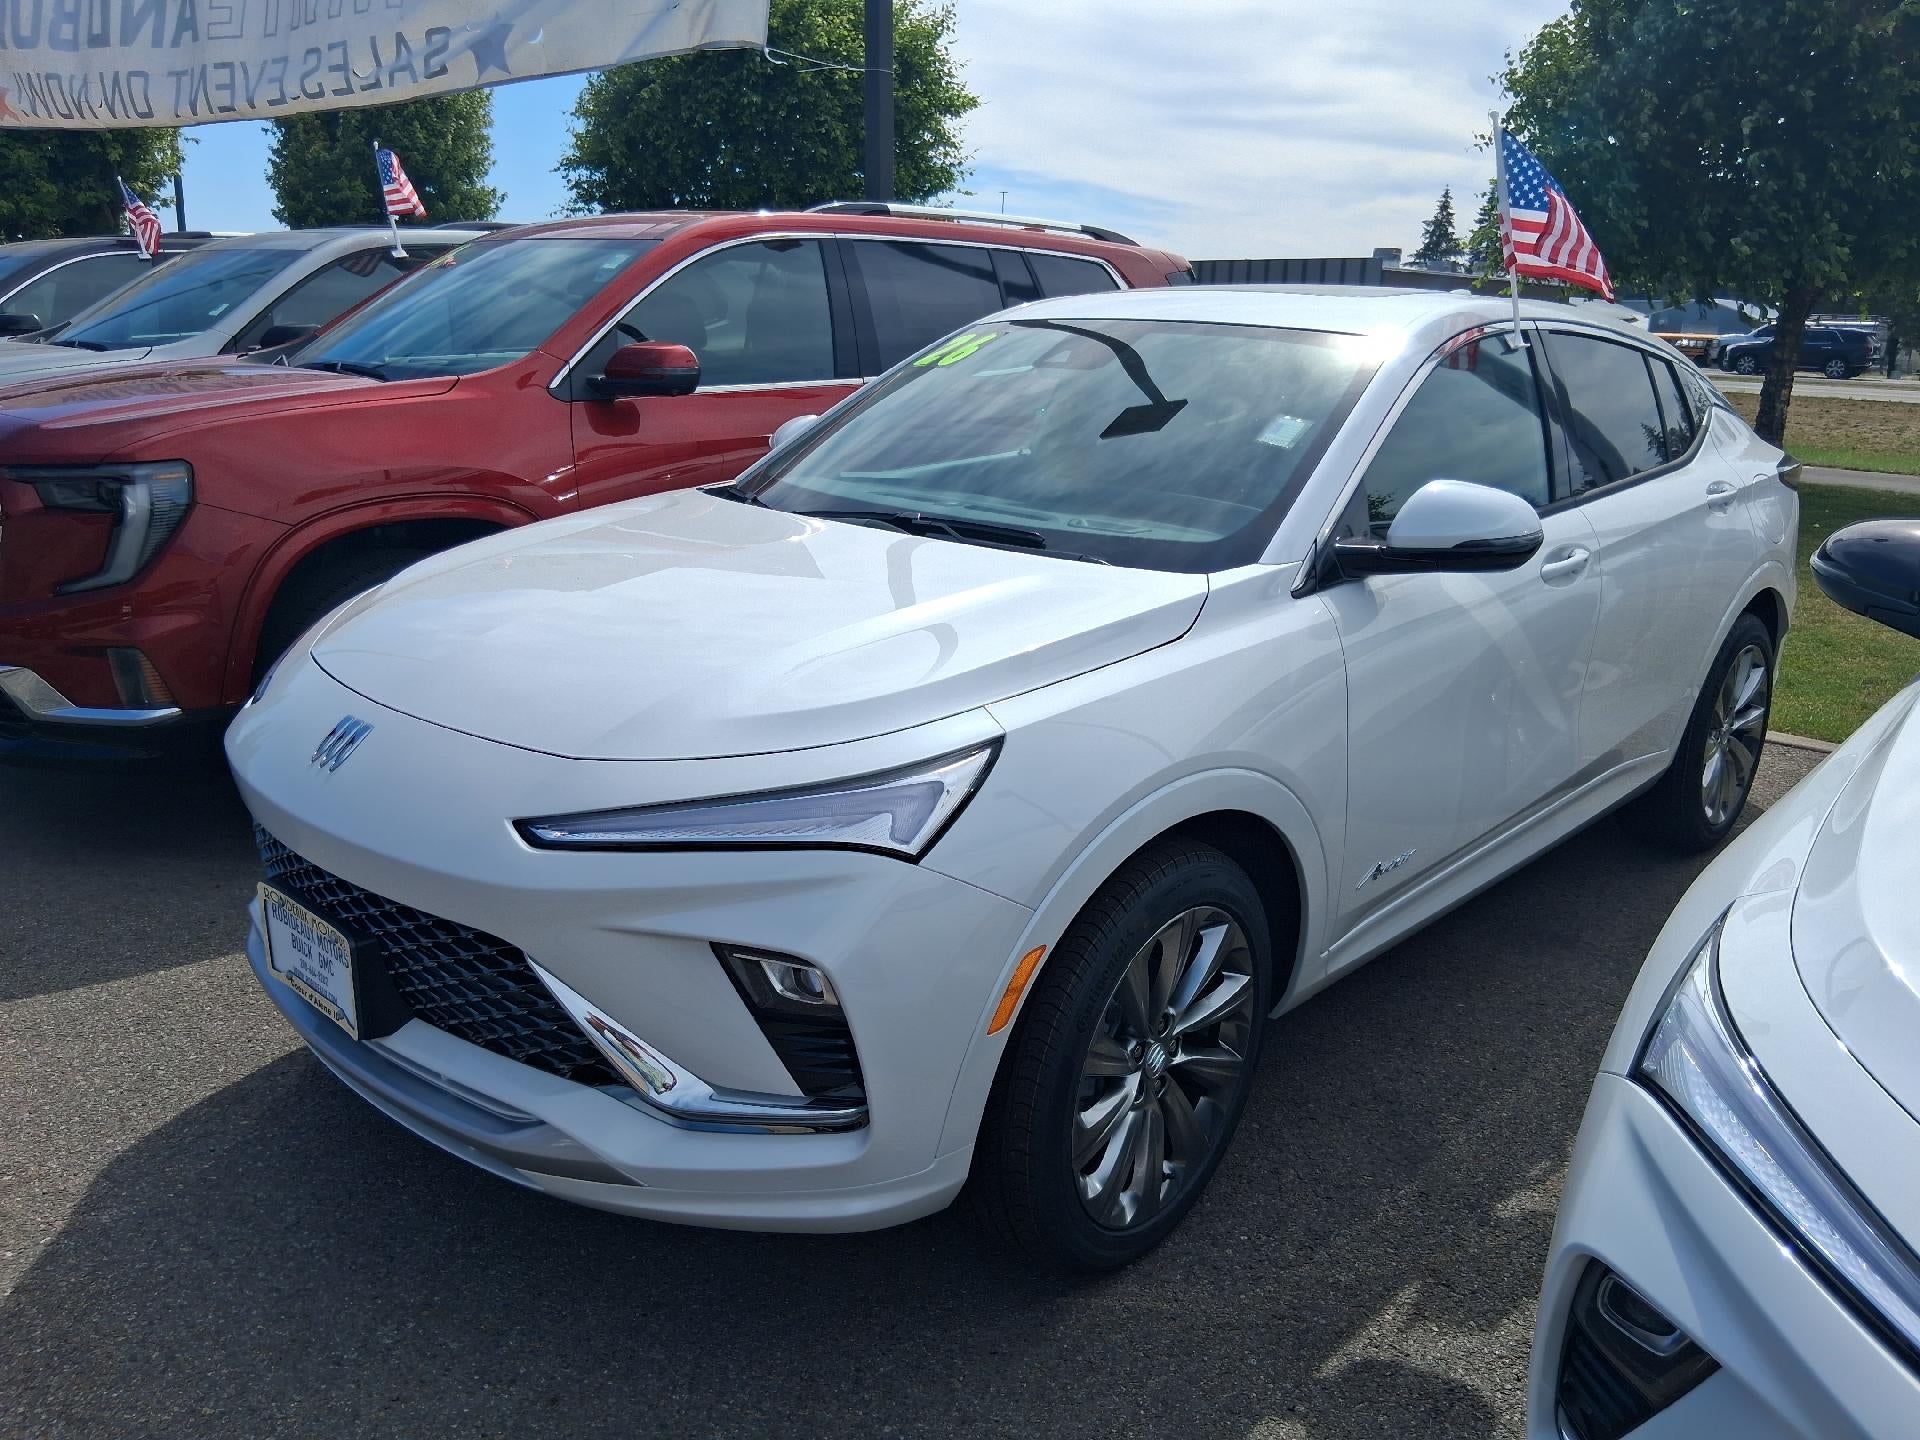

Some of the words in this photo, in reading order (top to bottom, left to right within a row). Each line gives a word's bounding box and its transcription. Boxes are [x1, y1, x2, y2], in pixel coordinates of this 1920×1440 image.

[271, 903, 315, 945] ROBIDEAUX
[316, 933, 349, 968] MOTORS
[291, 932, 312, 960] BUICK
[319, 951, 335, 976] GMC
